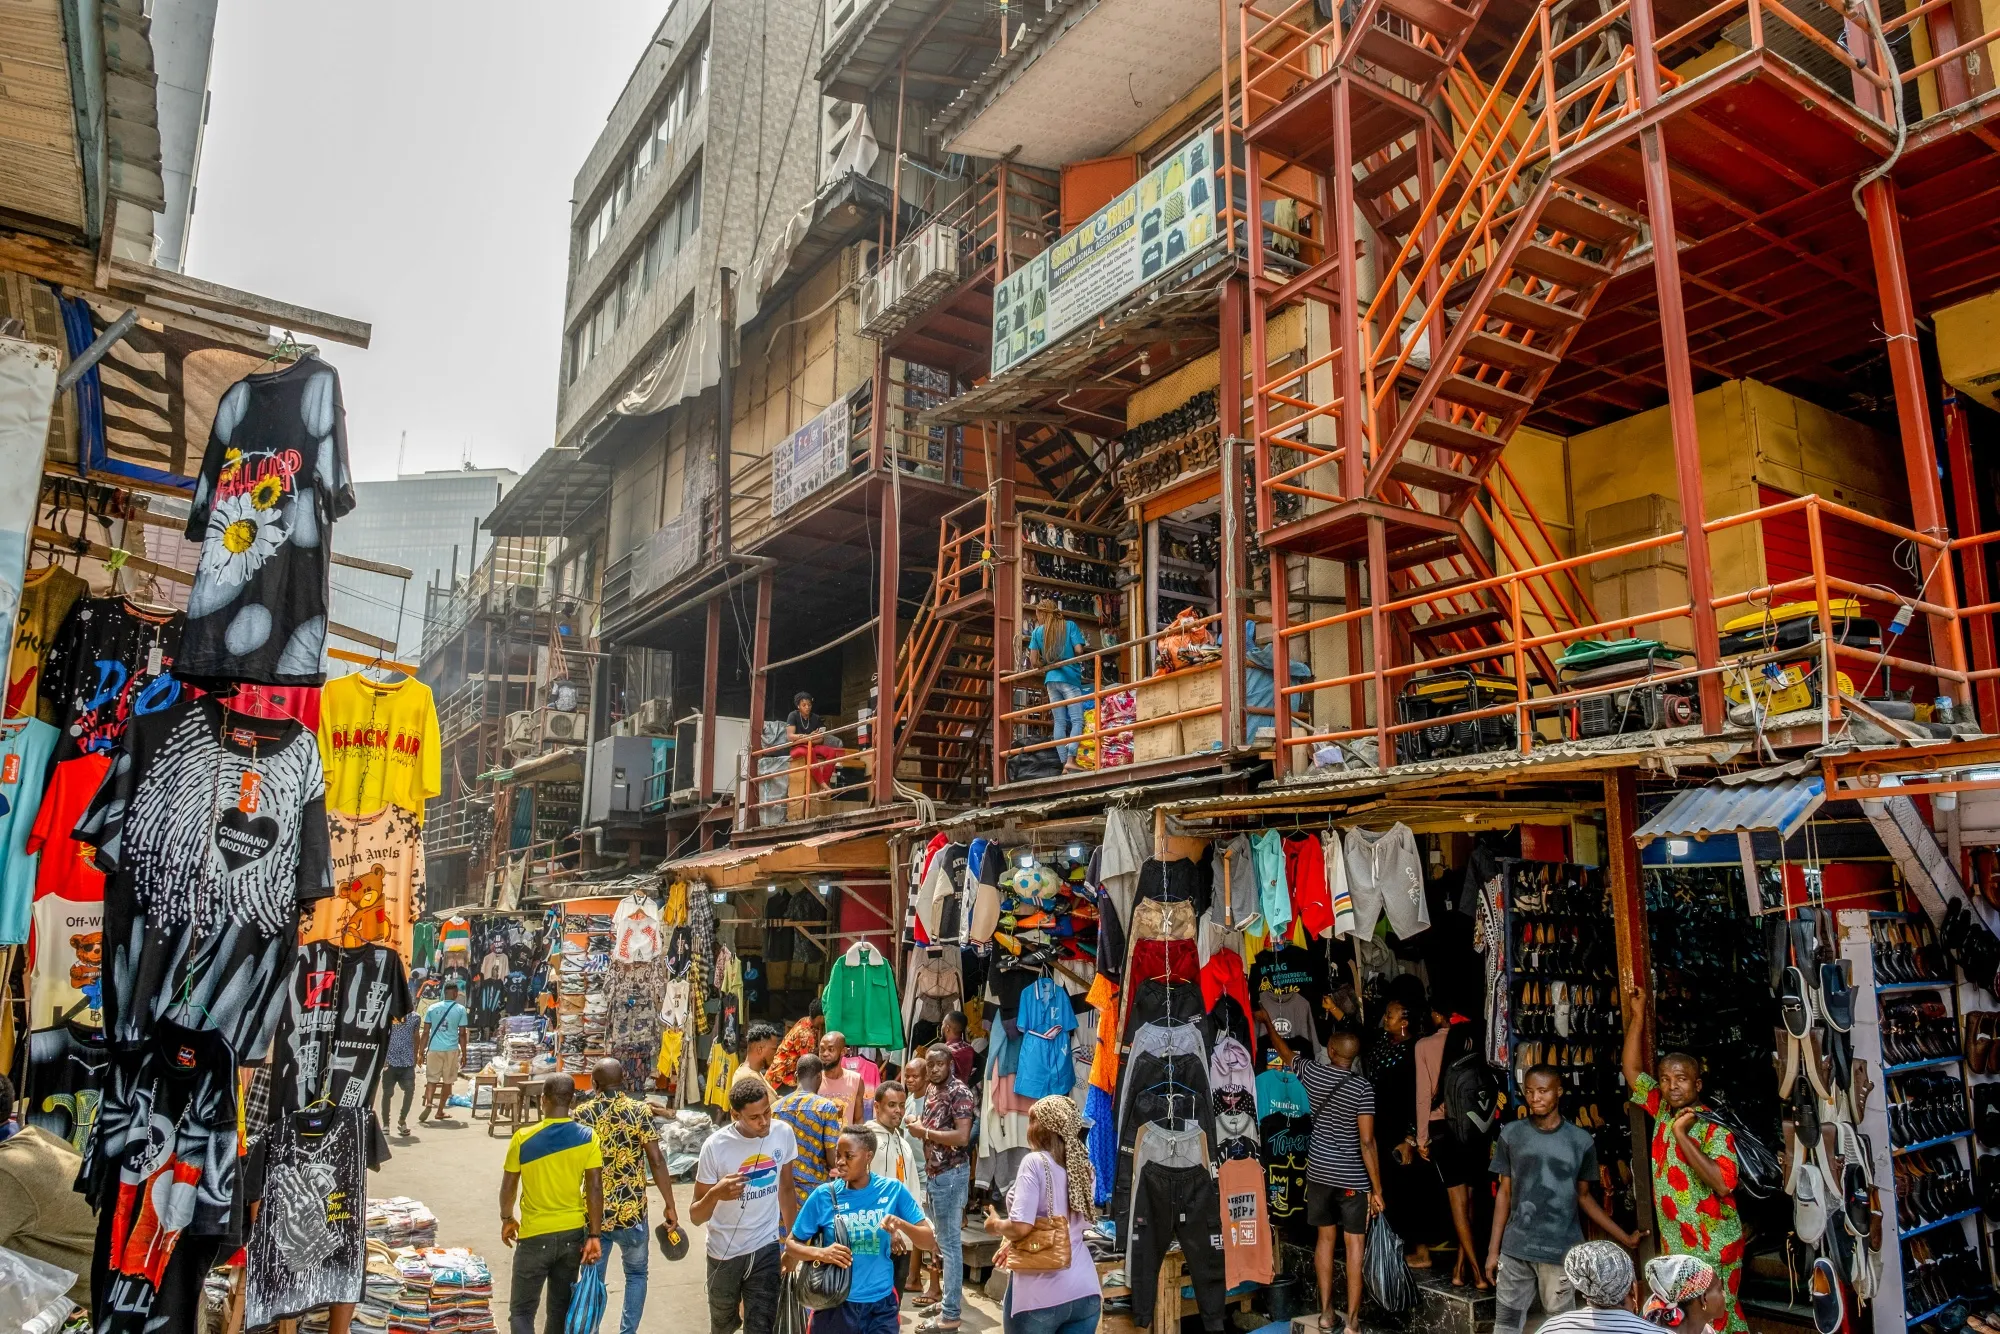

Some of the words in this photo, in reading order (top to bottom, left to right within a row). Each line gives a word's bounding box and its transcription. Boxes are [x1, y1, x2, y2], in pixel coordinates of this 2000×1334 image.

[1050, 234, 1078, 271] SKY
[1079, 192, 1134, 251] WORLD
[1053, 245, 1094, 279] INTERNATIONAL
[1095, 229, 1117, 250] AGENCY
[1119, 219, 1131, 233] LTD.
[1090, 257, 1106, 270] Designer
[1106, 247, 1120, 259] Clothes
[1102, 260, 1113, 270] Prada
[332, 728, 389, 752] BLACK
[392, 733, 421, 758] AIR
[219, 826, 269, 849] COMMAND
[219, 838, 261, 859] MODULE
[334, 1039, 379, 1051] HOMESICK
[747, 1188, 766, 1201] COLOR
[767, 1185, 777, 1196] RUN
